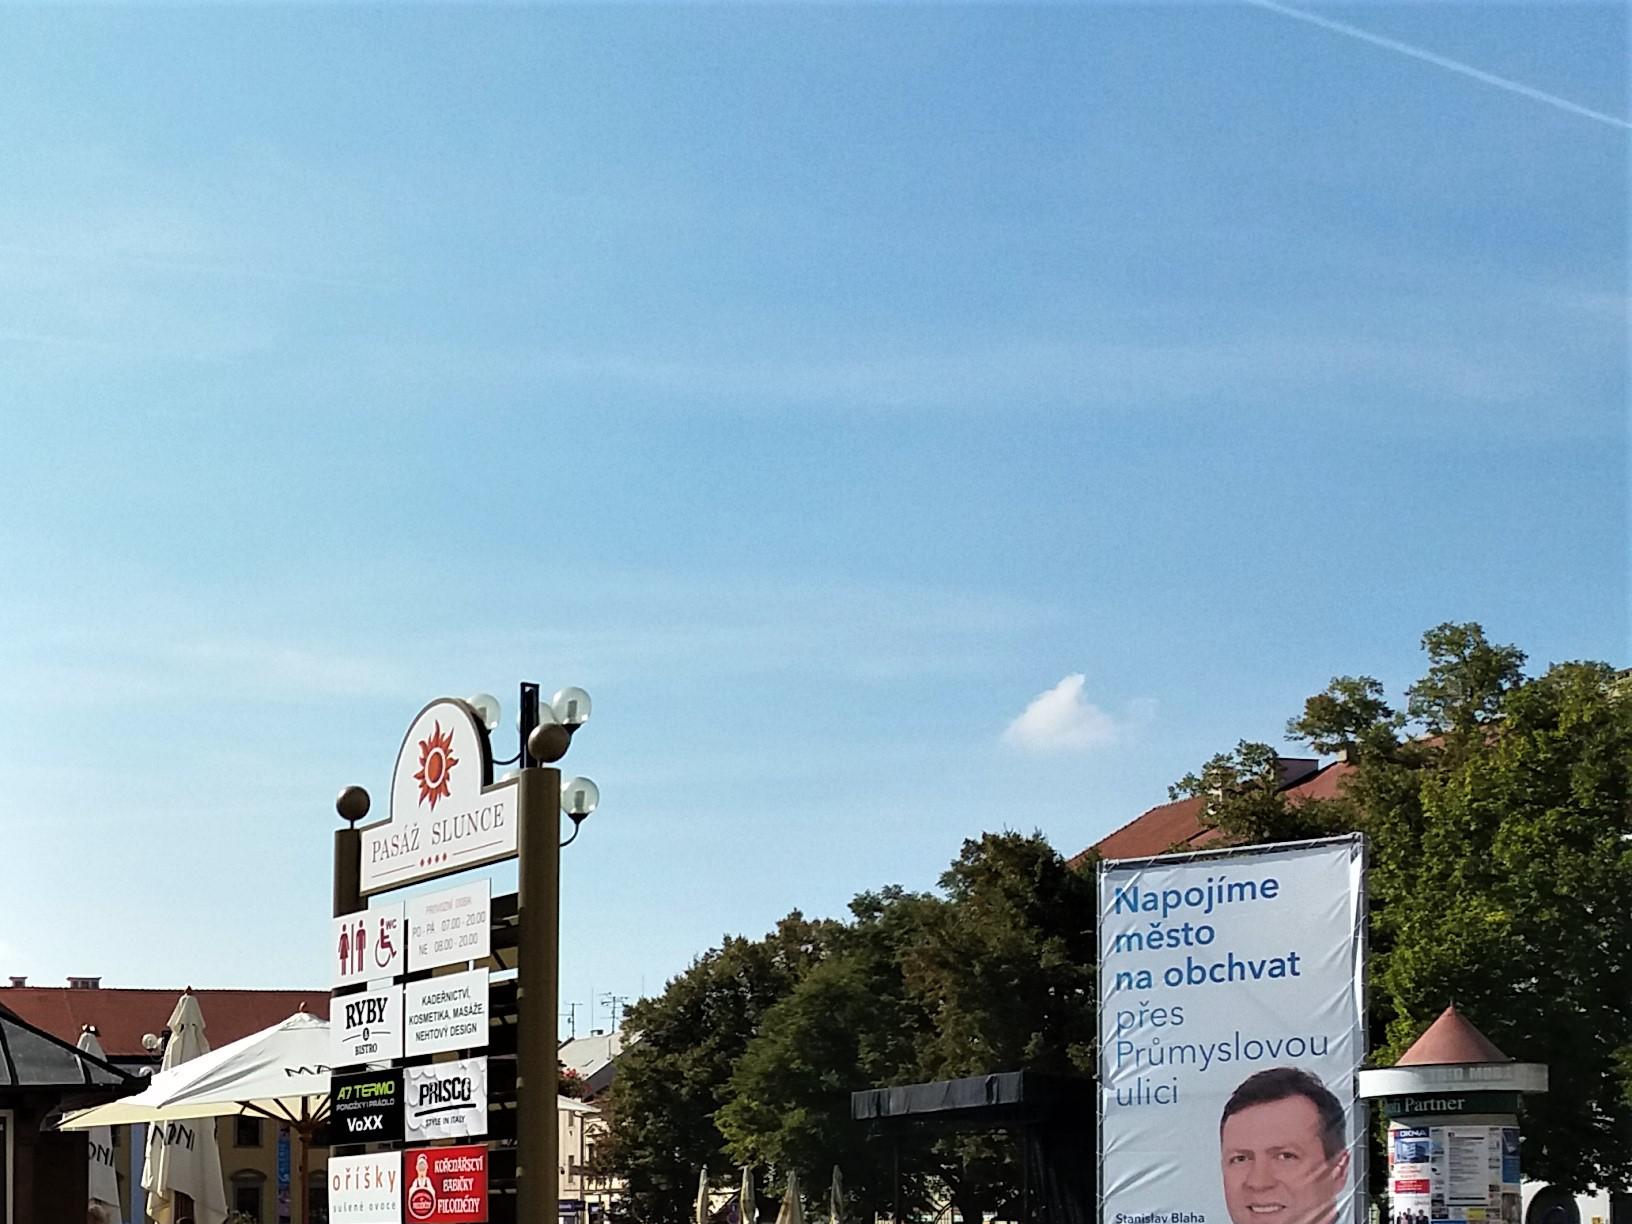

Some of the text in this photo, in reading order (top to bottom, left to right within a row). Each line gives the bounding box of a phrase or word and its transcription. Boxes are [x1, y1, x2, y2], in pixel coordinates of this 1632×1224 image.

[431, 803, 504, 845] SLUNCE
[1115, 876, 1279, 918] Napojíme
[386, 919, 397, 930] WC
[1116, 922, 1215, 953] město
[1116, 952, 1301, 991] na obchvat
[346, 997, 388, 1029] RYBY
[1117, 1000, 1185, 1037] přes
[450, 1022, 477, 1037] DESIGN
[355, 1043, 378, 1056] BISTRO
[1117, 1031, 1329, 1071] Průmyslovou
[337, 1081, 395, 1100] A7 TERMO
[419, 1077, 472, 1106] PRISCO
[1117, 1077, 1179, 1107] ulici
[1404, 1097, 1466, 1112] Partner
[347, 1114, 383, 1132] VoXX
[333, 1165, 396, 1193] oříšky
[443, 1176, 474, 1192] BABIČKY
[1115, 1211, 1205, 1224] Stanislav Blaha
